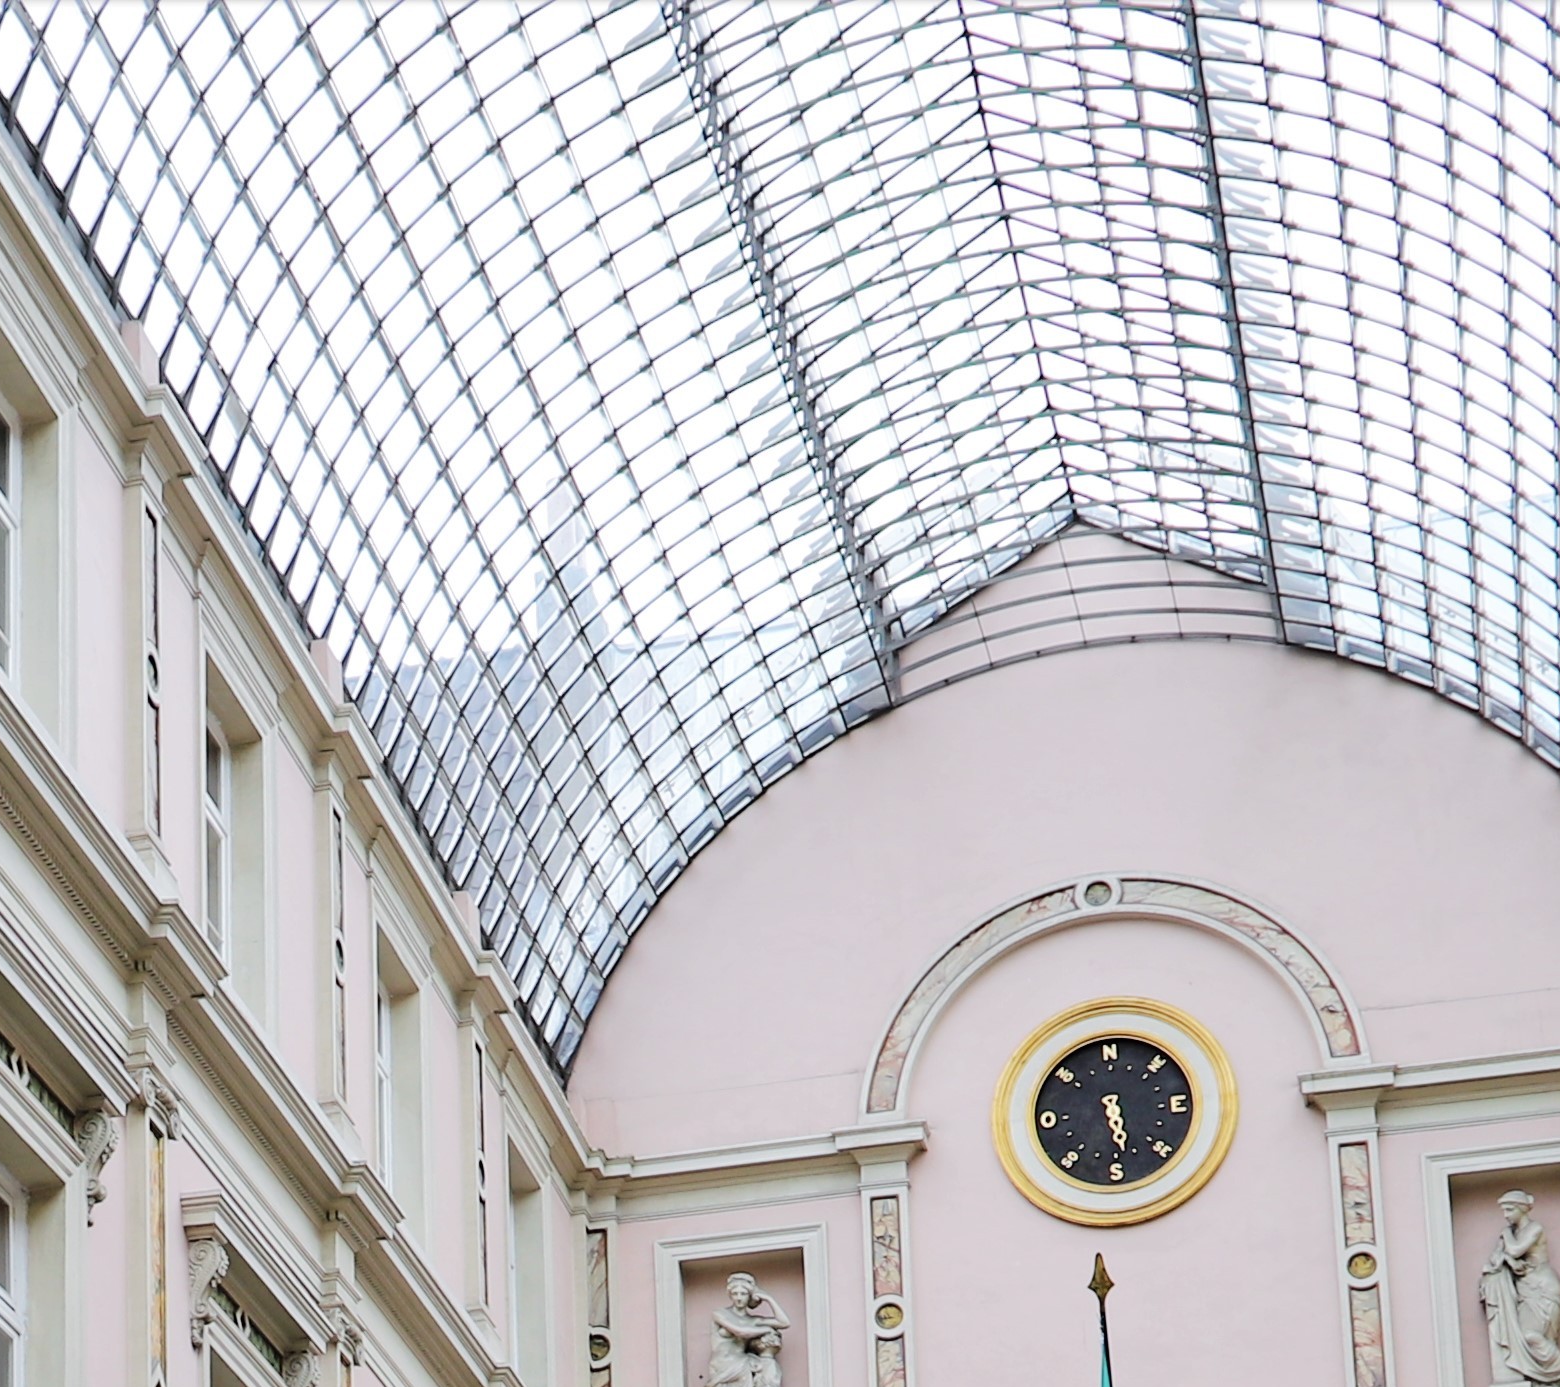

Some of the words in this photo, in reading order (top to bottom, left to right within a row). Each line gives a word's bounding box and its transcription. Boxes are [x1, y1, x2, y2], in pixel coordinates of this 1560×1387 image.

[1102, 1044, 1118, 1061] N
[1147, 1054, 1167, 1073] NE
[1055, 1066, 1074, 1083] NO
[1170, 1095, 1188, 1113] E
[1040, 1110, 1057, 1128] O
[1152, 1140, 1172, 1158] SE
[1061, 1151, 1079, 1169] SO
[1110, 1163, 1124, 1181] S
